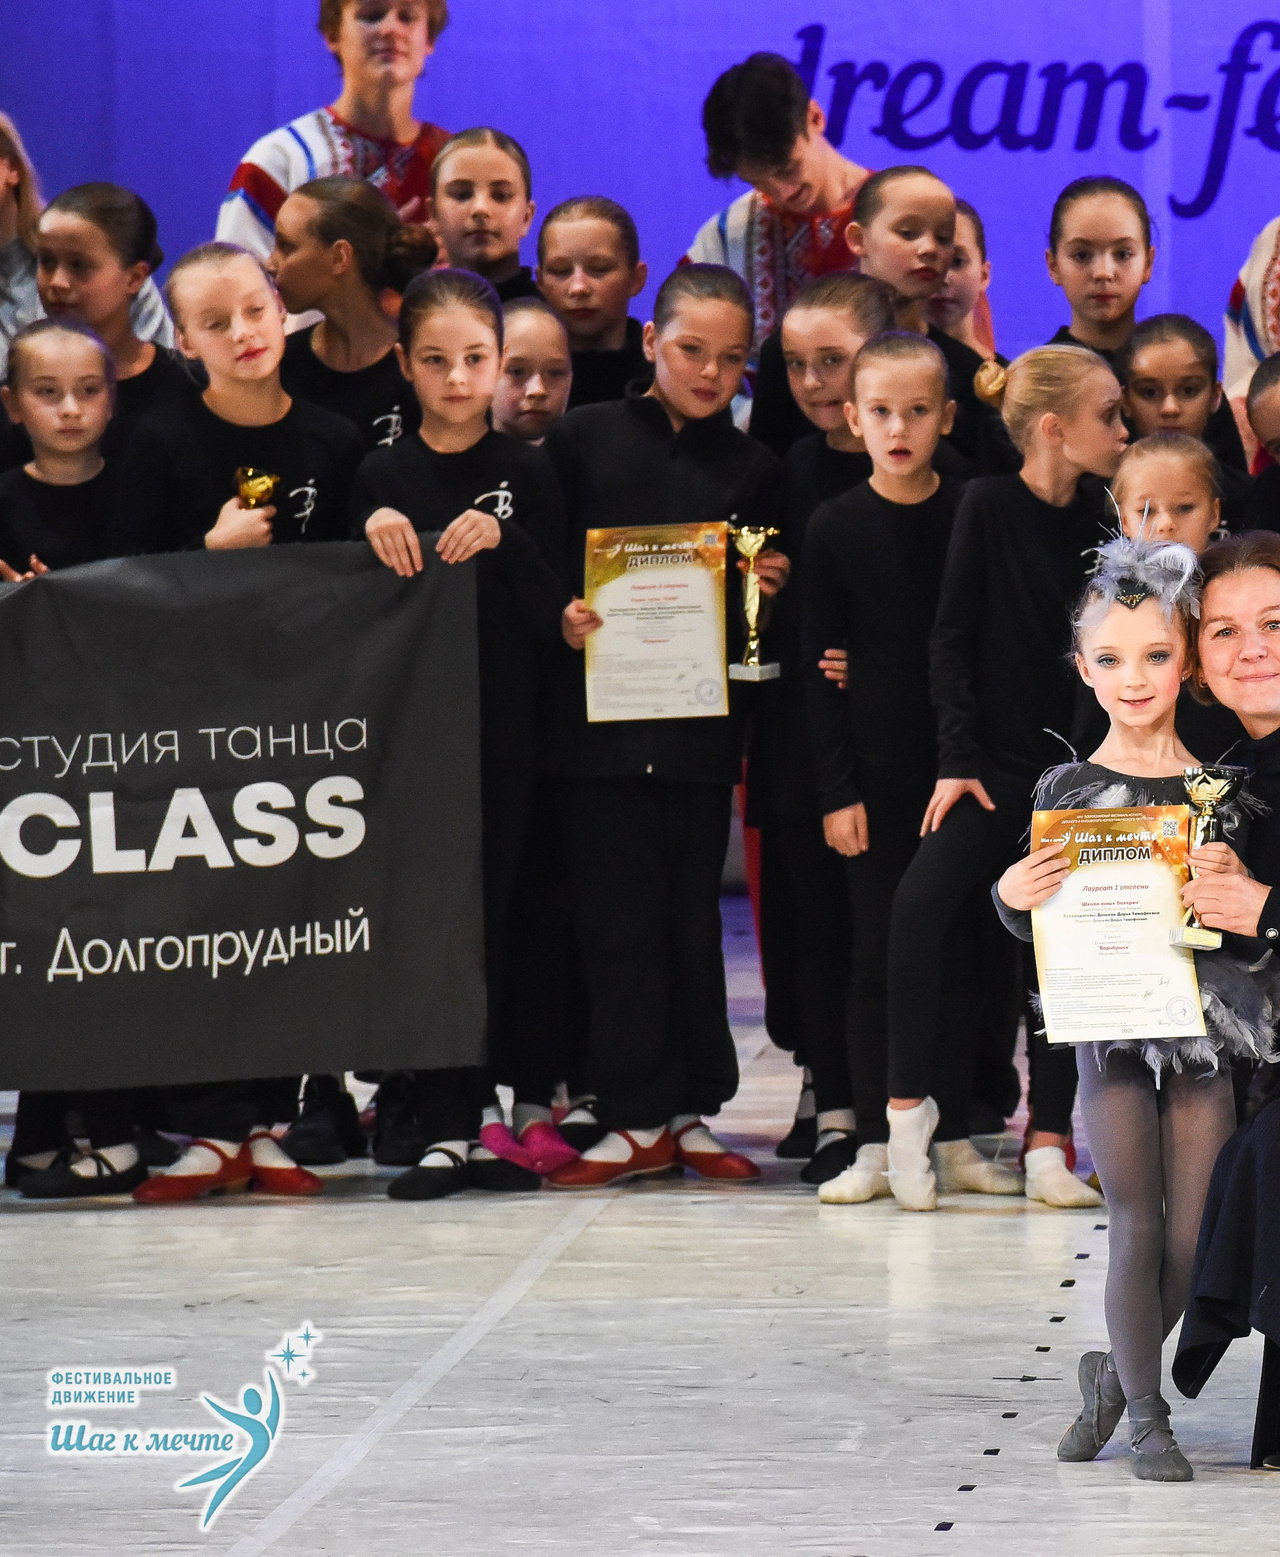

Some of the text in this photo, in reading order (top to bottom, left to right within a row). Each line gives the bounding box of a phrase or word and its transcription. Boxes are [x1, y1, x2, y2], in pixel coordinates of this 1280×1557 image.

[629, 554, 692, 568] ДИПЛОМ
[0, 718, 368, 778] студия танца
[0, 775, 366, 878] CLASS
[1075, 831, 1158, 843] Шаг к мечте
[1079, 847, 1151, 865] ДИПЛОМ
[47, 907, 370, 983] Долгопрудный
